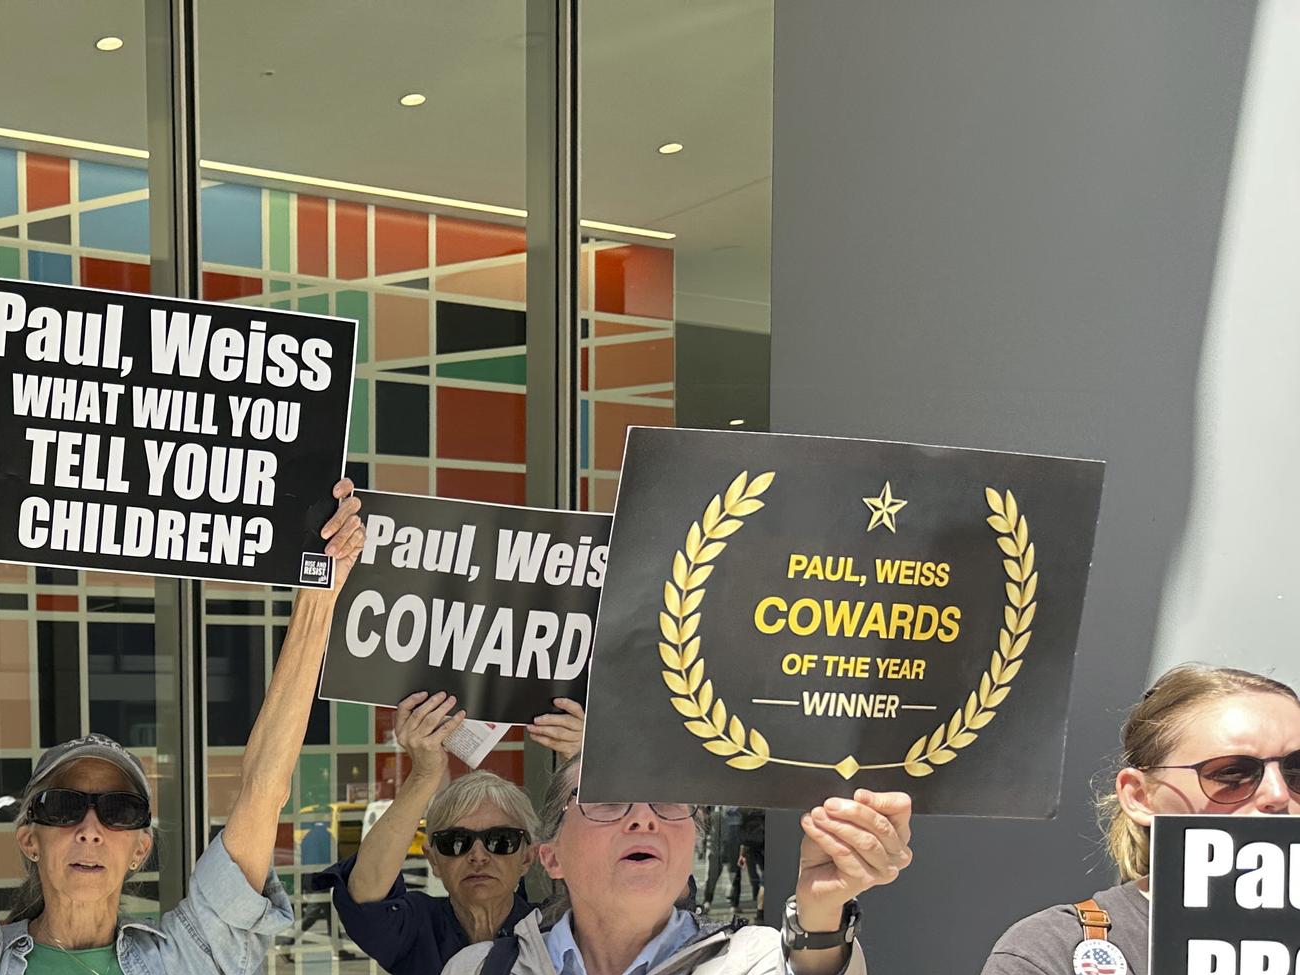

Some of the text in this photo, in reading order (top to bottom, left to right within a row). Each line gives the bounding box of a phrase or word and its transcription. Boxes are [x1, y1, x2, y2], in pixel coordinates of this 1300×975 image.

[150, 308, 333, 392] Weiss
[12, 373, 301, 443] WHAT WILL YOU
[25, 427, 278, 507] TELL YOUR
[18, 496, 274, 567] CHILDREN?
[360, 514, 609, 588] Paul, Weis
[787, 553, 950, 588] PAUL, WEISS
[753, 595, 962, 643] COWARDS
[781, 652, 926, 680] OF THE YEAR
[802, 690, 900, 719] WINNER
